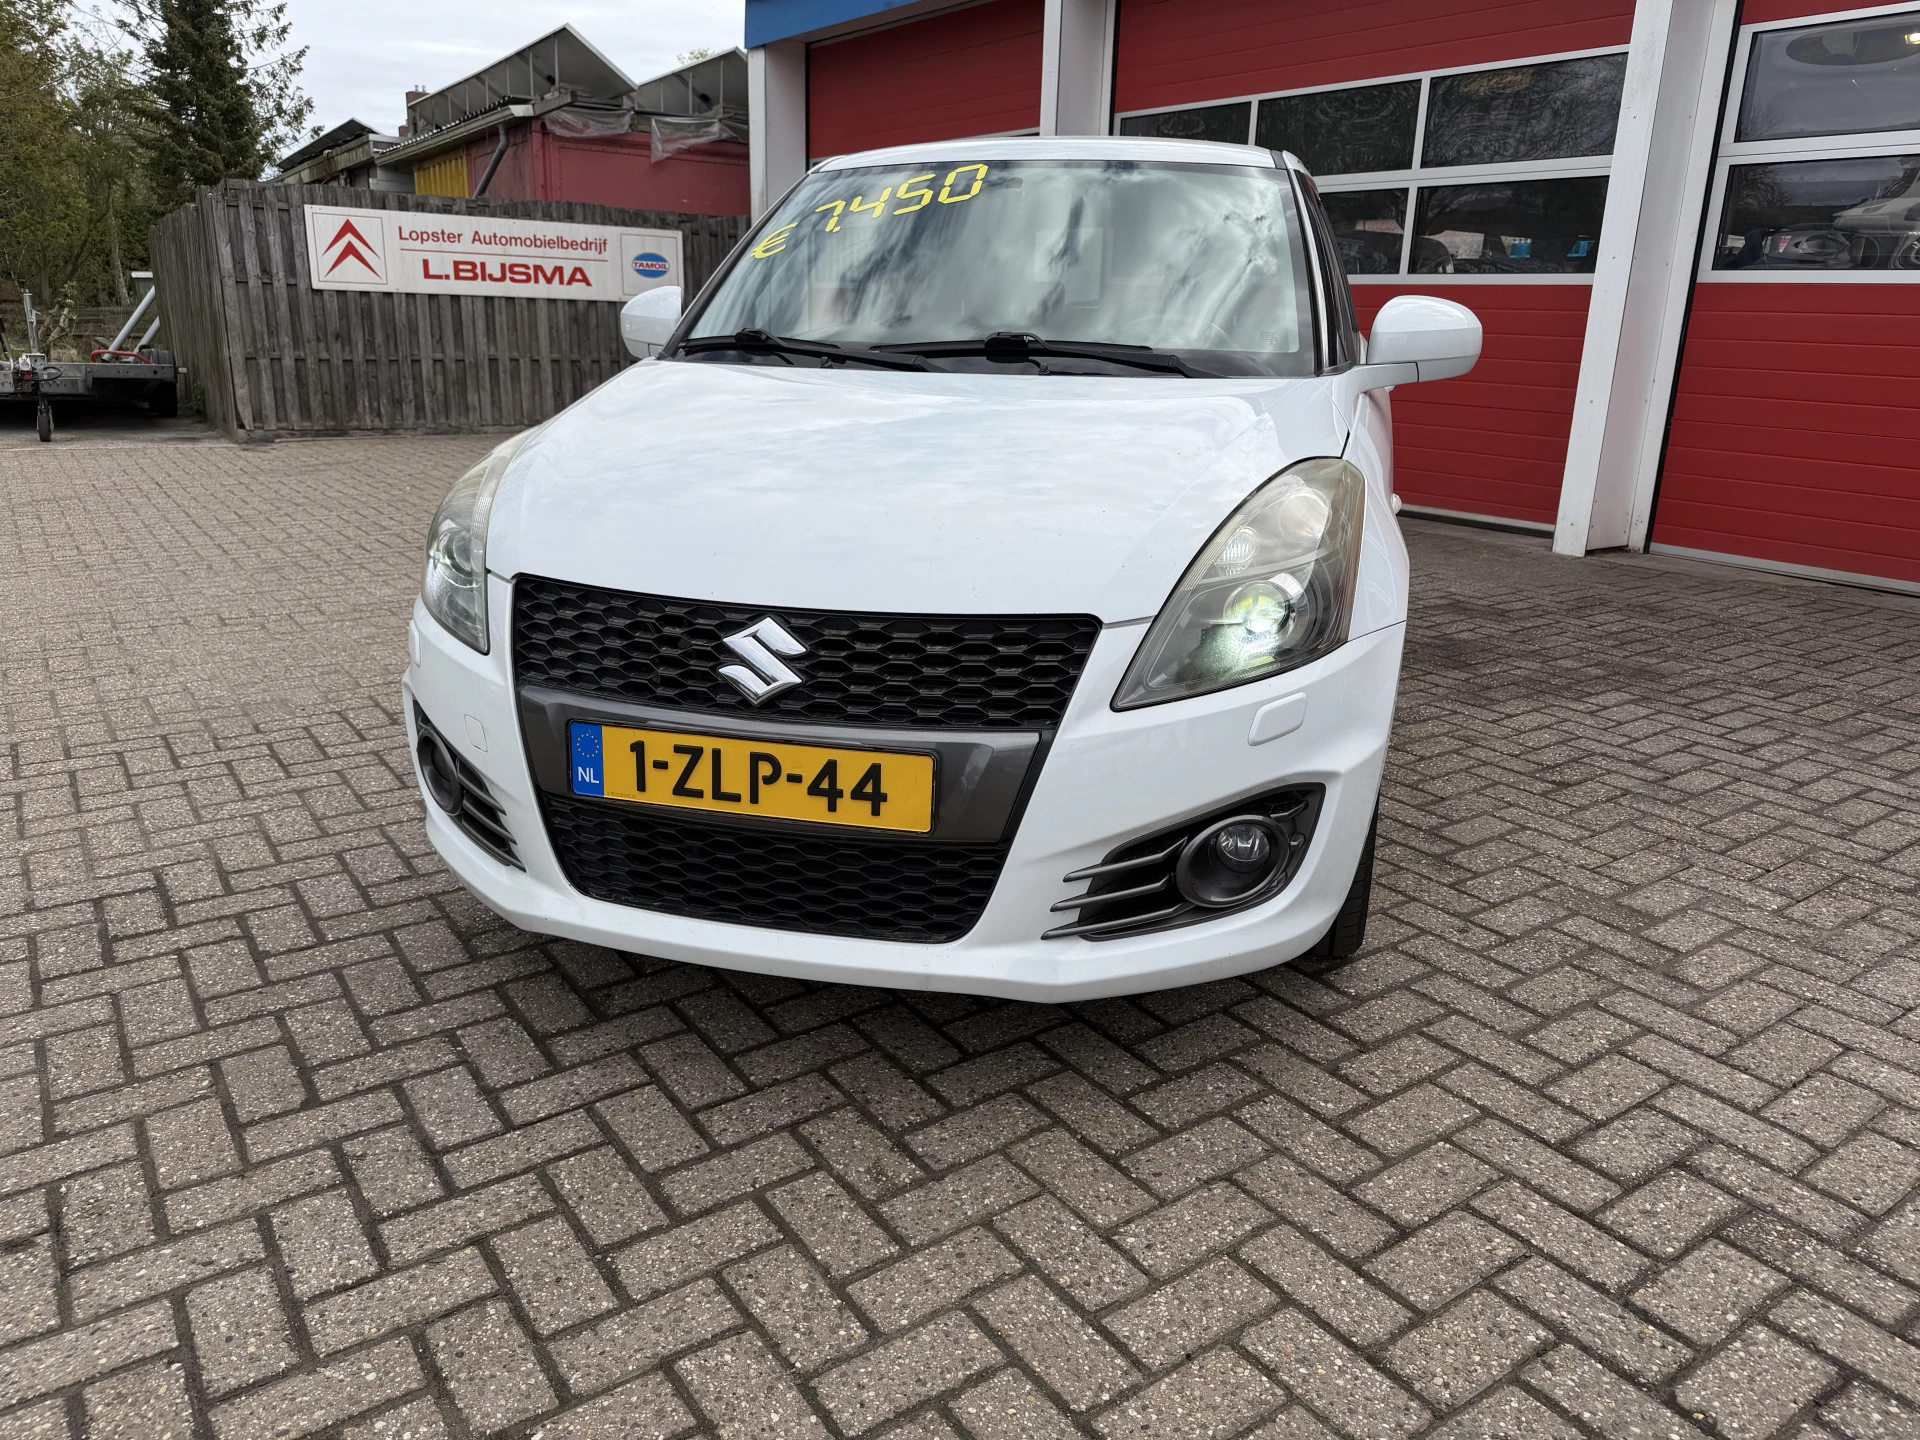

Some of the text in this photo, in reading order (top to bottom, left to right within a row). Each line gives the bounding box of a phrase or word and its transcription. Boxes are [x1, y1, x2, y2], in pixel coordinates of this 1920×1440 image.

[750, 163, 989, 259] € 7.450
[398, 226, 609, 254] Lopster Automobielbedrijf
[421, 258, 593, 287] L.BIJSMA
[633, 261, 669, 271] TAMOIL
[577, 766, 600, 784] NL
[629, 740, 888, 817] 1-ZLP-44
